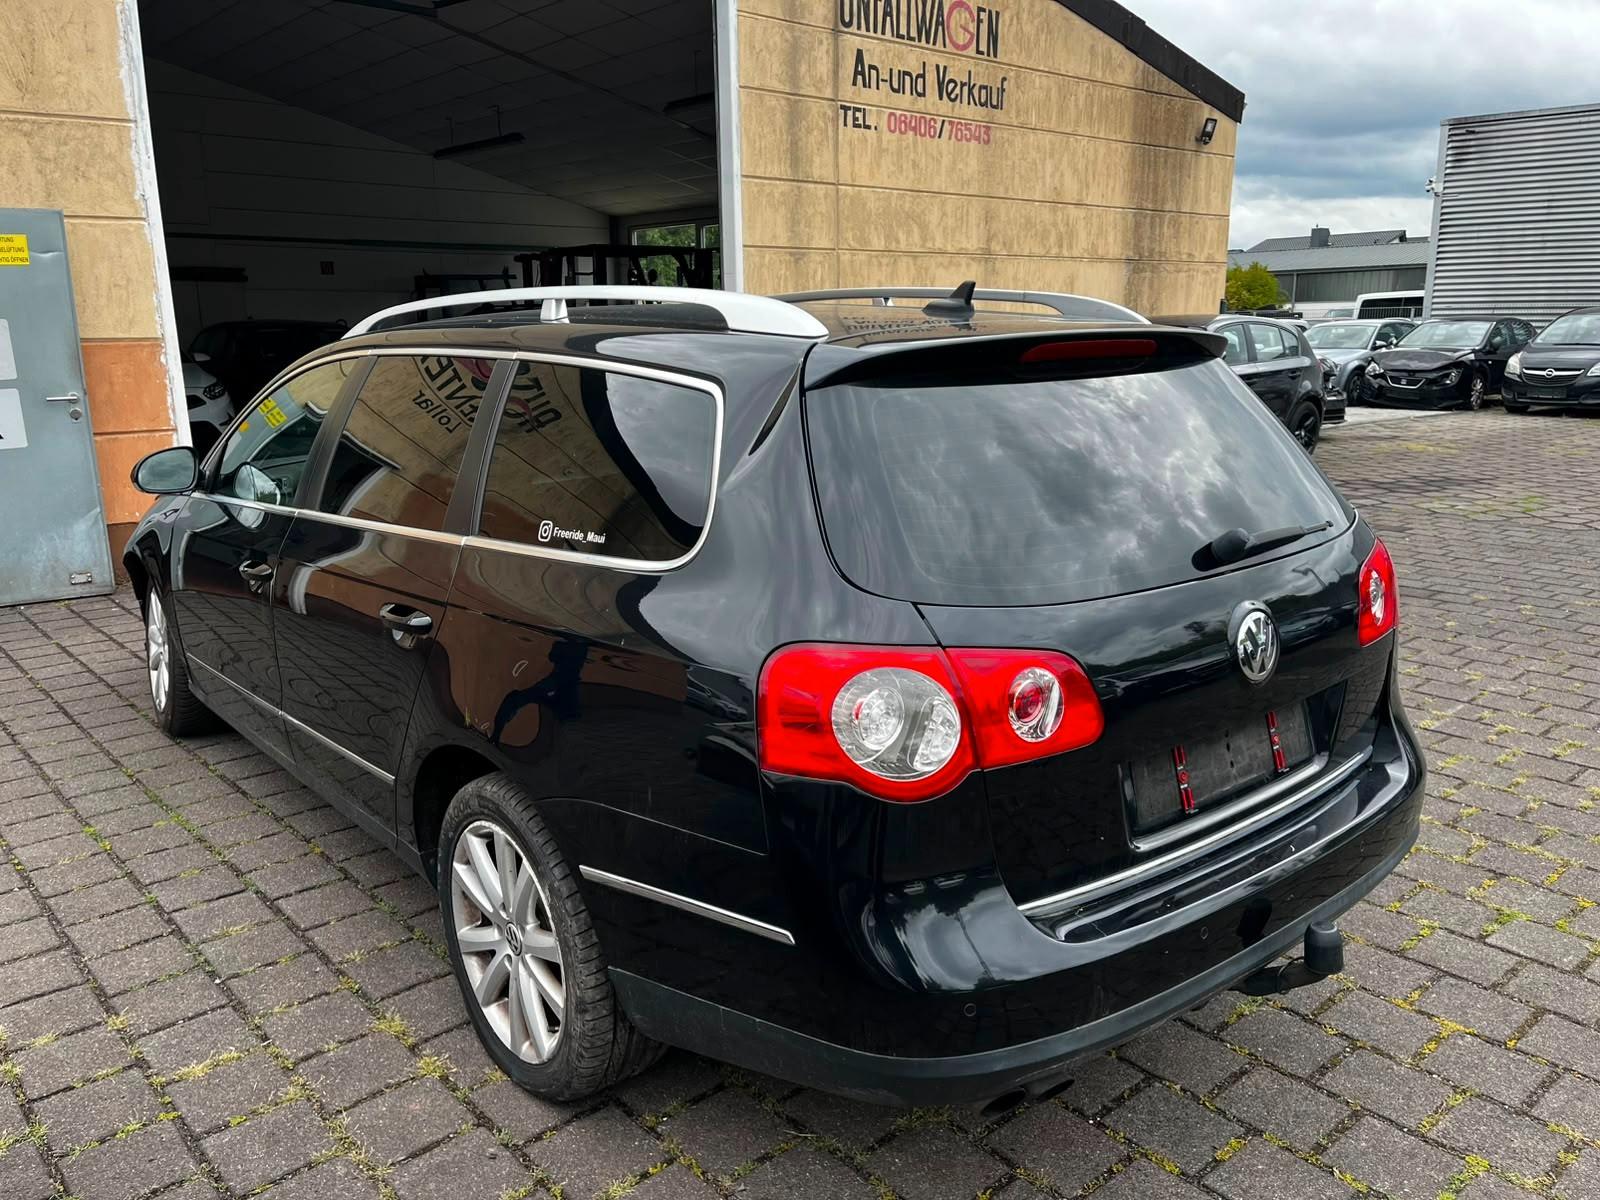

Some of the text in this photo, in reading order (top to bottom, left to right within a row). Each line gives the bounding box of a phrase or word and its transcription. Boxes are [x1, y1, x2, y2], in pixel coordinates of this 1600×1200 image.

[852, 48, 1007, 110] An-und Verkauf
[839, 104, 878, 131] TEL.
[553, 526, 606, 543] Freeride_Maui
